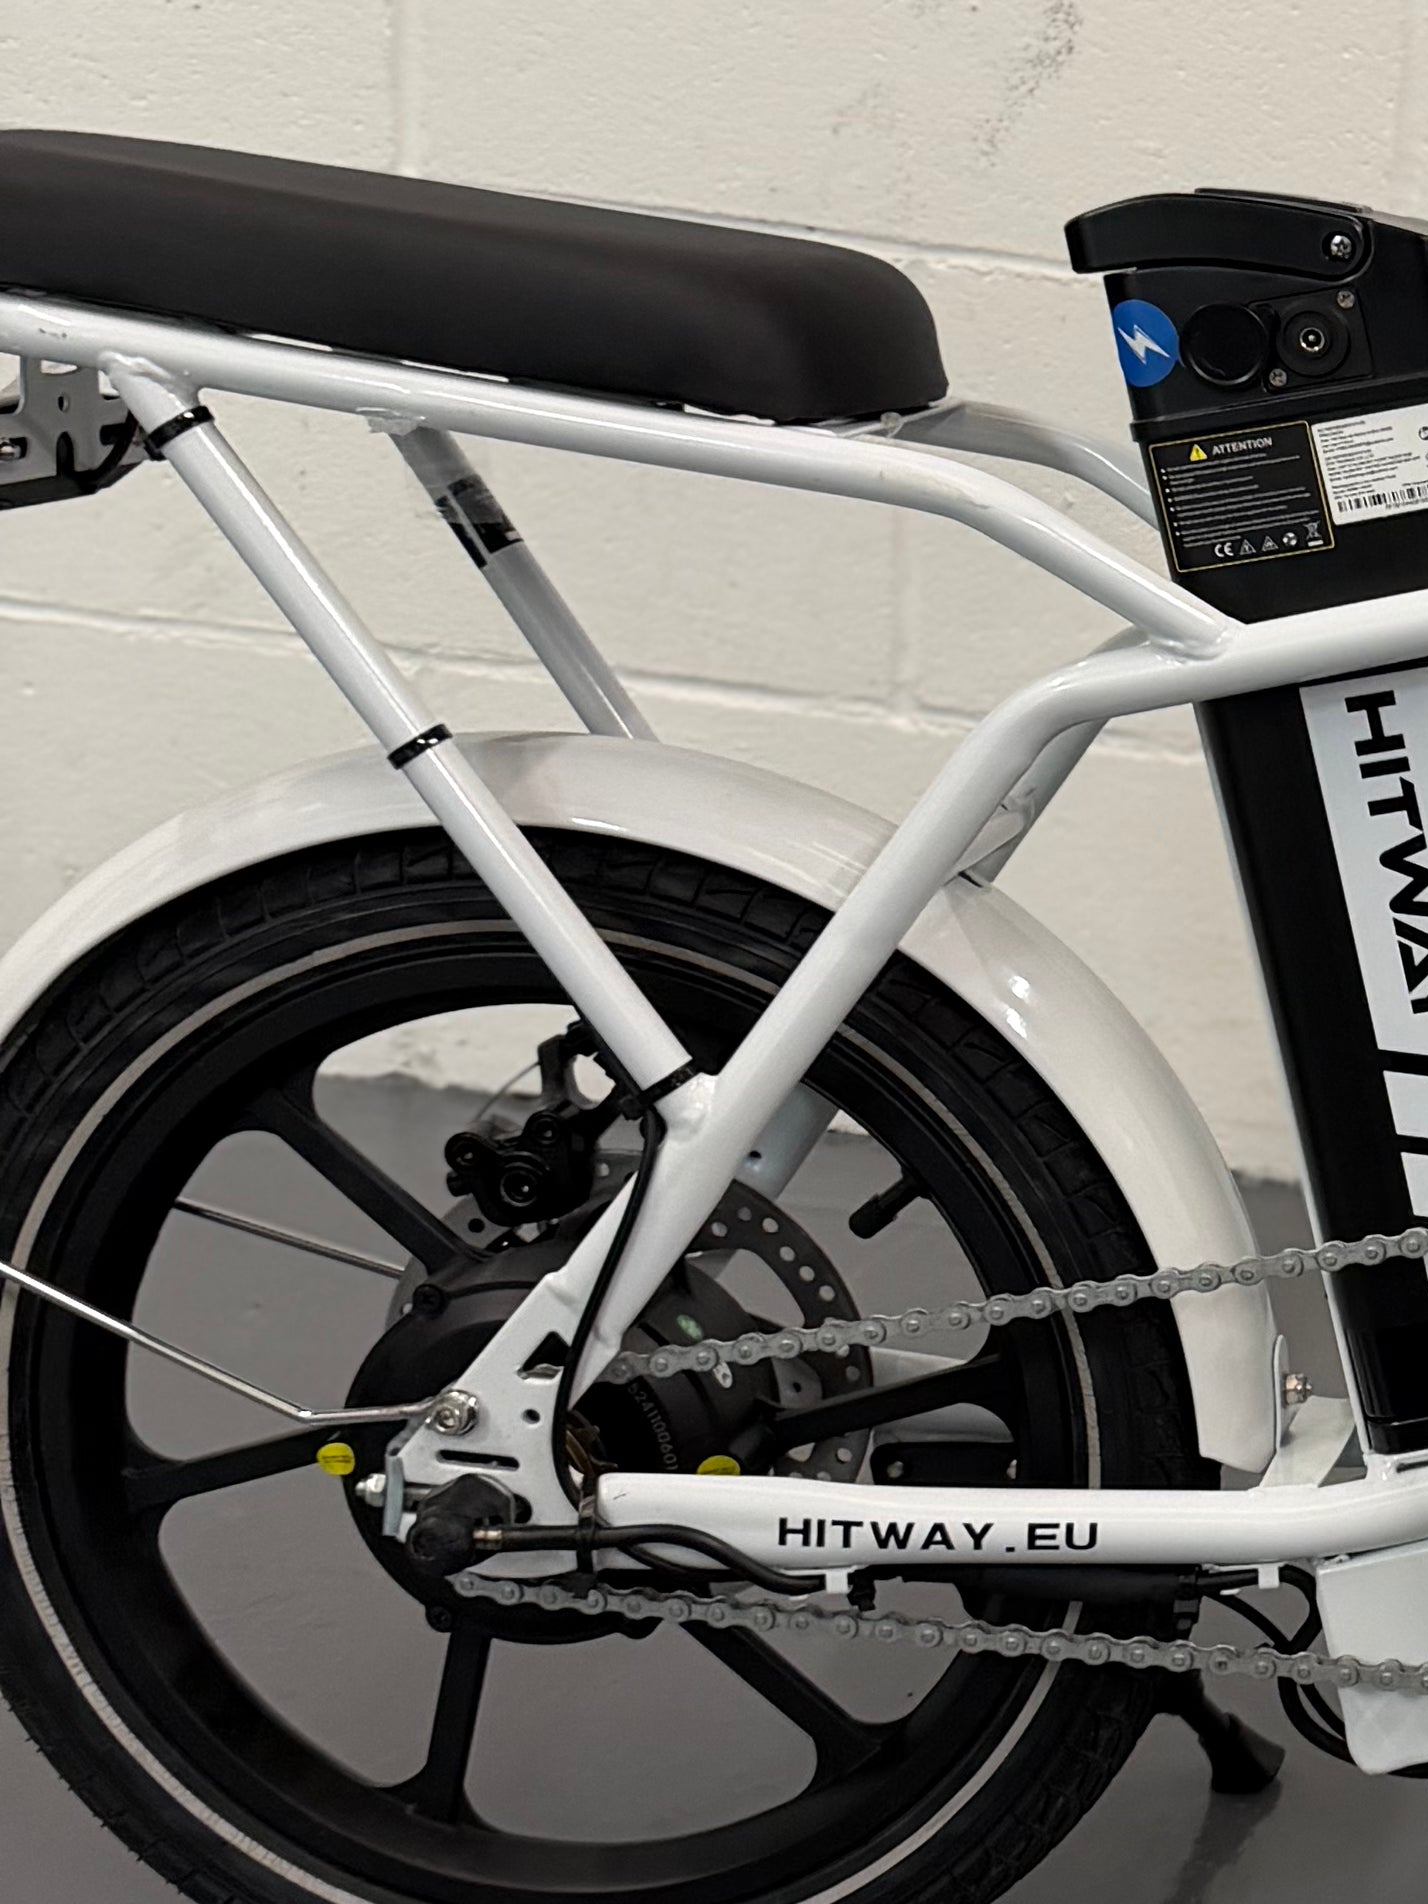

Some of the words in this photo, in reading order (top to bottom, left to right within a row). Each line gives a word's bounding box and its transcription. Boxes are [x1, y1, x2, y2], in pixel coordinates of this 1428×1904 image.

[1212, 437, 1272, 455] ATTENTION
[1214, 542, 1234, 557] CE
[778, 1517, 1098, 1553] HITWAY.EU
